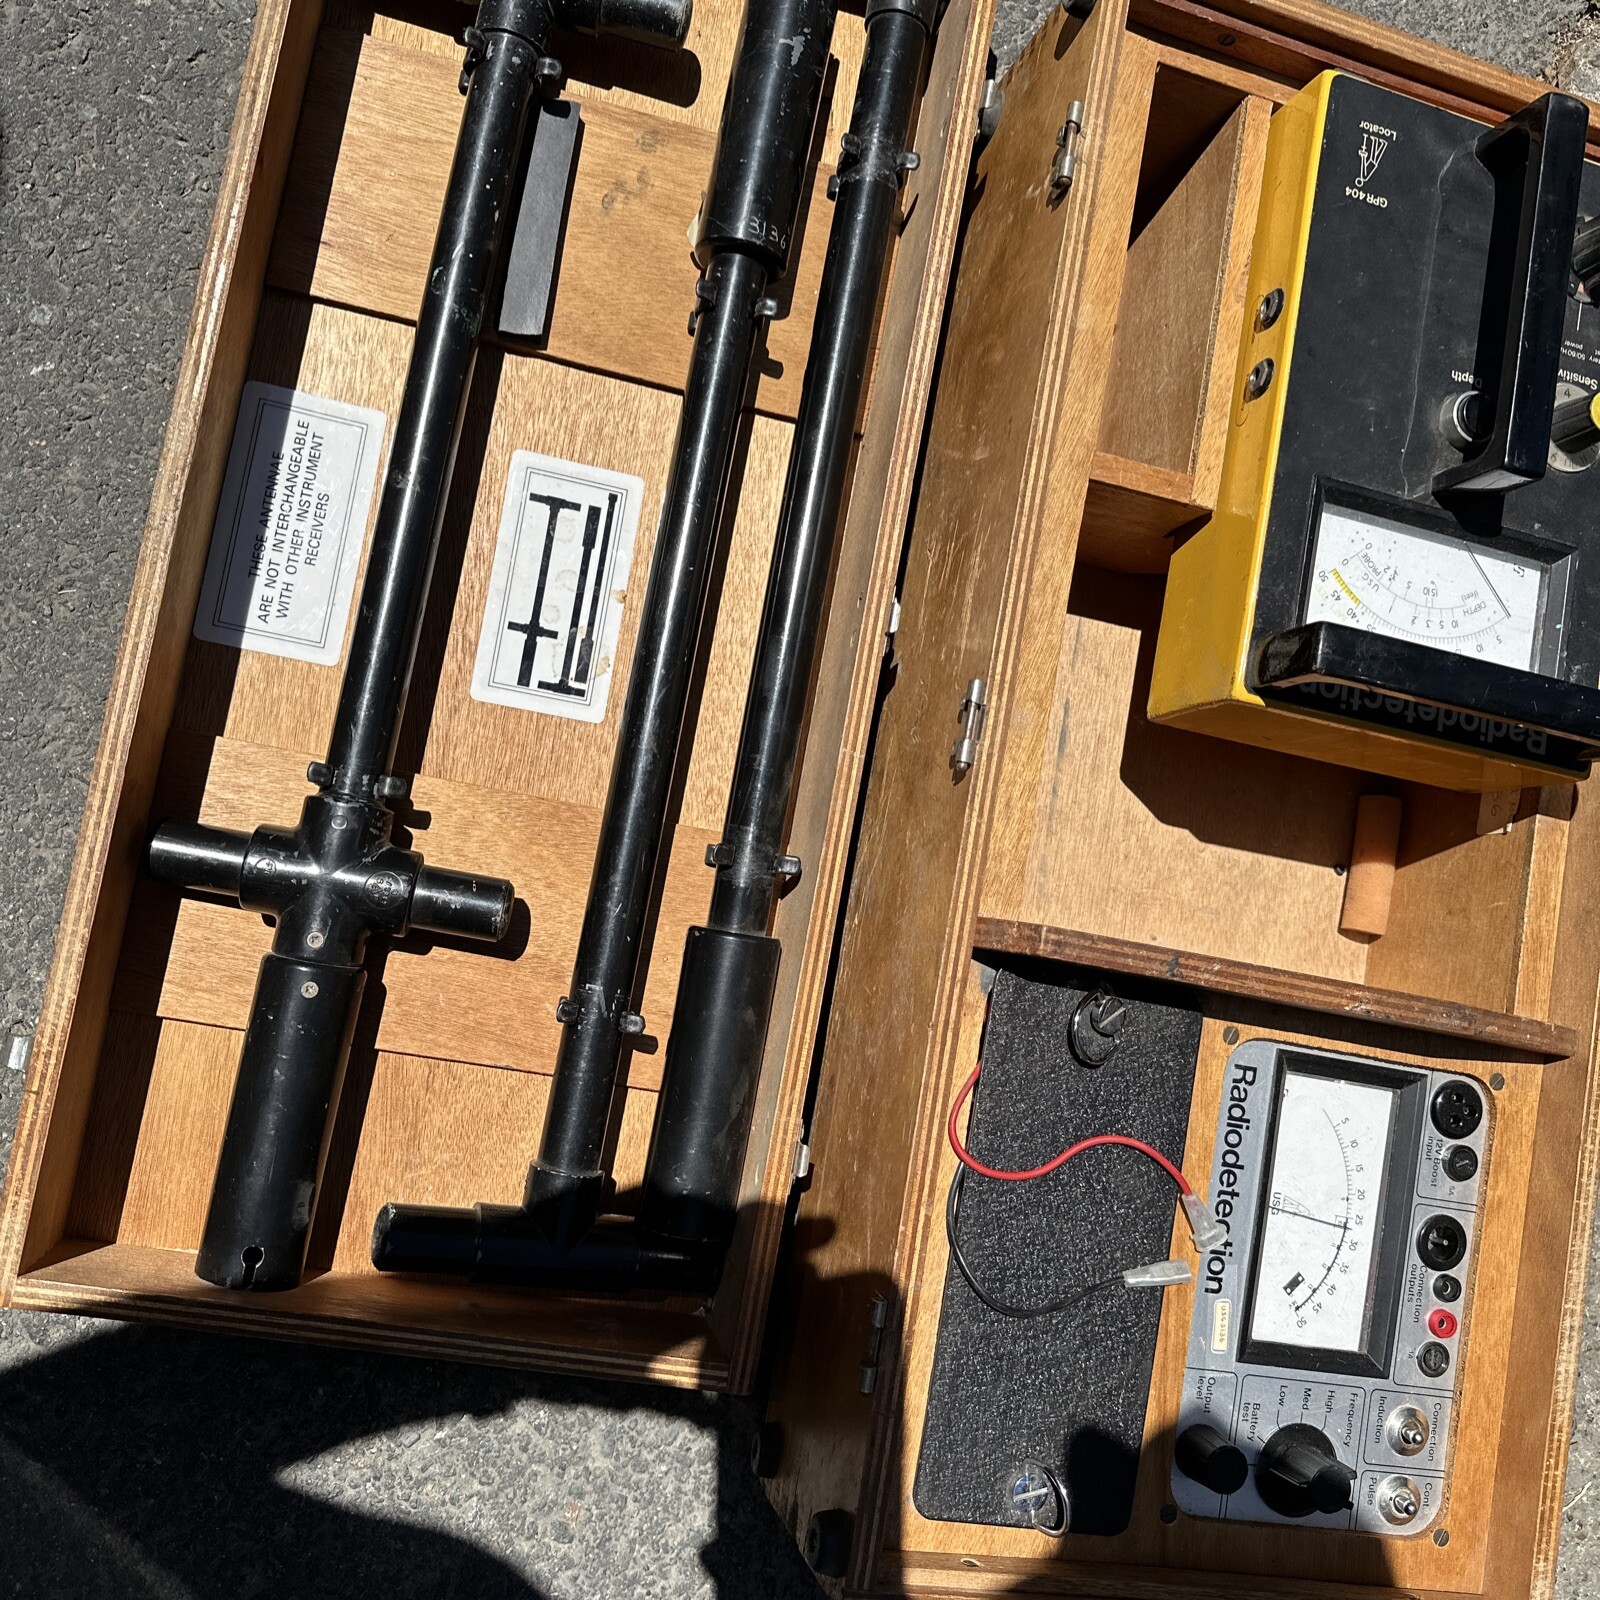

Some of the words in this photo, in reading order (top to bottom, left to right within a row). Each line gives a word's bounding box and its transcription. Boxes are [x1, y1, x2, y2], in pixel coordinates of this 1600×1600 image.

[1359, 120, 1397, 141] Locator
[1344, 186, 1366, 200] 404
[1366, 193, 1388, 208] GPR
[748, 216, 786, 249] 3136
[1564, 340, 1583, 349] power
[1452, 370, 1482, 388] Depth
[1558, 369, 1598, 390] Sensitiv
[1564, 388, 1571, 398] 4
[272, 420, 310, 553] INTERCHANGEABLE
[248, 534, 268, 578] THESE
[258, 451, 284, 528] ANTENNAE
[276, 582, 294, 618] WITH
[285, 529, 305, 575] OTHER
[296, 432, 324, 522] INSTRUMENT
[305, 492, 330, 566] RECEIVERS
[1365, 542, 1373, 550] 0
[1341, 558, 1349, 566] 0
[1361, 552, 1381, 576] PROBE
[1383, 565, 1390, 573] 2
[264, 559, 280, 589] NOT
[1318, 570, 1329, 582] 50
[1361, 572, 1379, 592] USG
[1406, 581, 1412, 589] 5
[1331, 590, 1342, 601] 45
[1422, 586, 1430, 595] 10
[1430, 588, 1439, 597] 15
[1461, 590, 1479, 601] (feet)
[257, 595, 273, 624] ARE
[1346, 608, 1358, 619] 40
[1463, 601, 1486, 616] DEPTH
[1411, 615, 1417, 625] 2
[1425, 619, 1432, 628] 3
[1438, 620, 1445, 629] 5
[1450, 619, 1460, 629] 10
[1494, 634, 1503, 644] 5
[1474, 643, 1485, 653] 10
[1340, 1117, 1349, 1125] 5
[1349, 1138, 1359, 1149] 10
[1426, 1136, 1434, 1160] input
[1435, 1138, 1443, 1155] 12V
[1355, 1164, 1364, 1173] 15
[1430, 1157, 1440, 1187] Boost
[1356, 1189, 1366, 1201] 20
[1448, 1186, 1455, 1195] 5A
[1271, 1192, 1281, 1215] USG
[1354, 1214, 1363, 1226] 25
[1348, 1239, 1358, 1251] 30
[1338, 1262, 1349, 1274] 35
[1325, 1283, 1337, 1296] 40
[1407, 1264, 1418, 1303] outputs
[1413, 1265, 1427, 1323] Connection
[1311, 1301, 1323, 1314] 45
[1295, 1316, 1307, 1329] 50
[1408, 1350, 1413, 1359] 1A
[1196, 1376, 1205, 1400] level
[1204, 1377, 1216, 1414] Output
[1279, 1385, 1288, 1406] Low
[1302, 1388, 1311, 1410] Med
[1325, 1390, 1335, 1413] High
[1242, 1403, 1251, 1422] test
[1343, 1393, 1357, 1447] Frequency
[1374, 1396, 1387, 1444] Induction
[1247, 1403, 1260, 1442] Battery
[1427, 1402, 1441, 1461] Connection
[1367, 1477, 1377, 1505] Pulse
[1423, 1483, 1432, 1507] Cont
